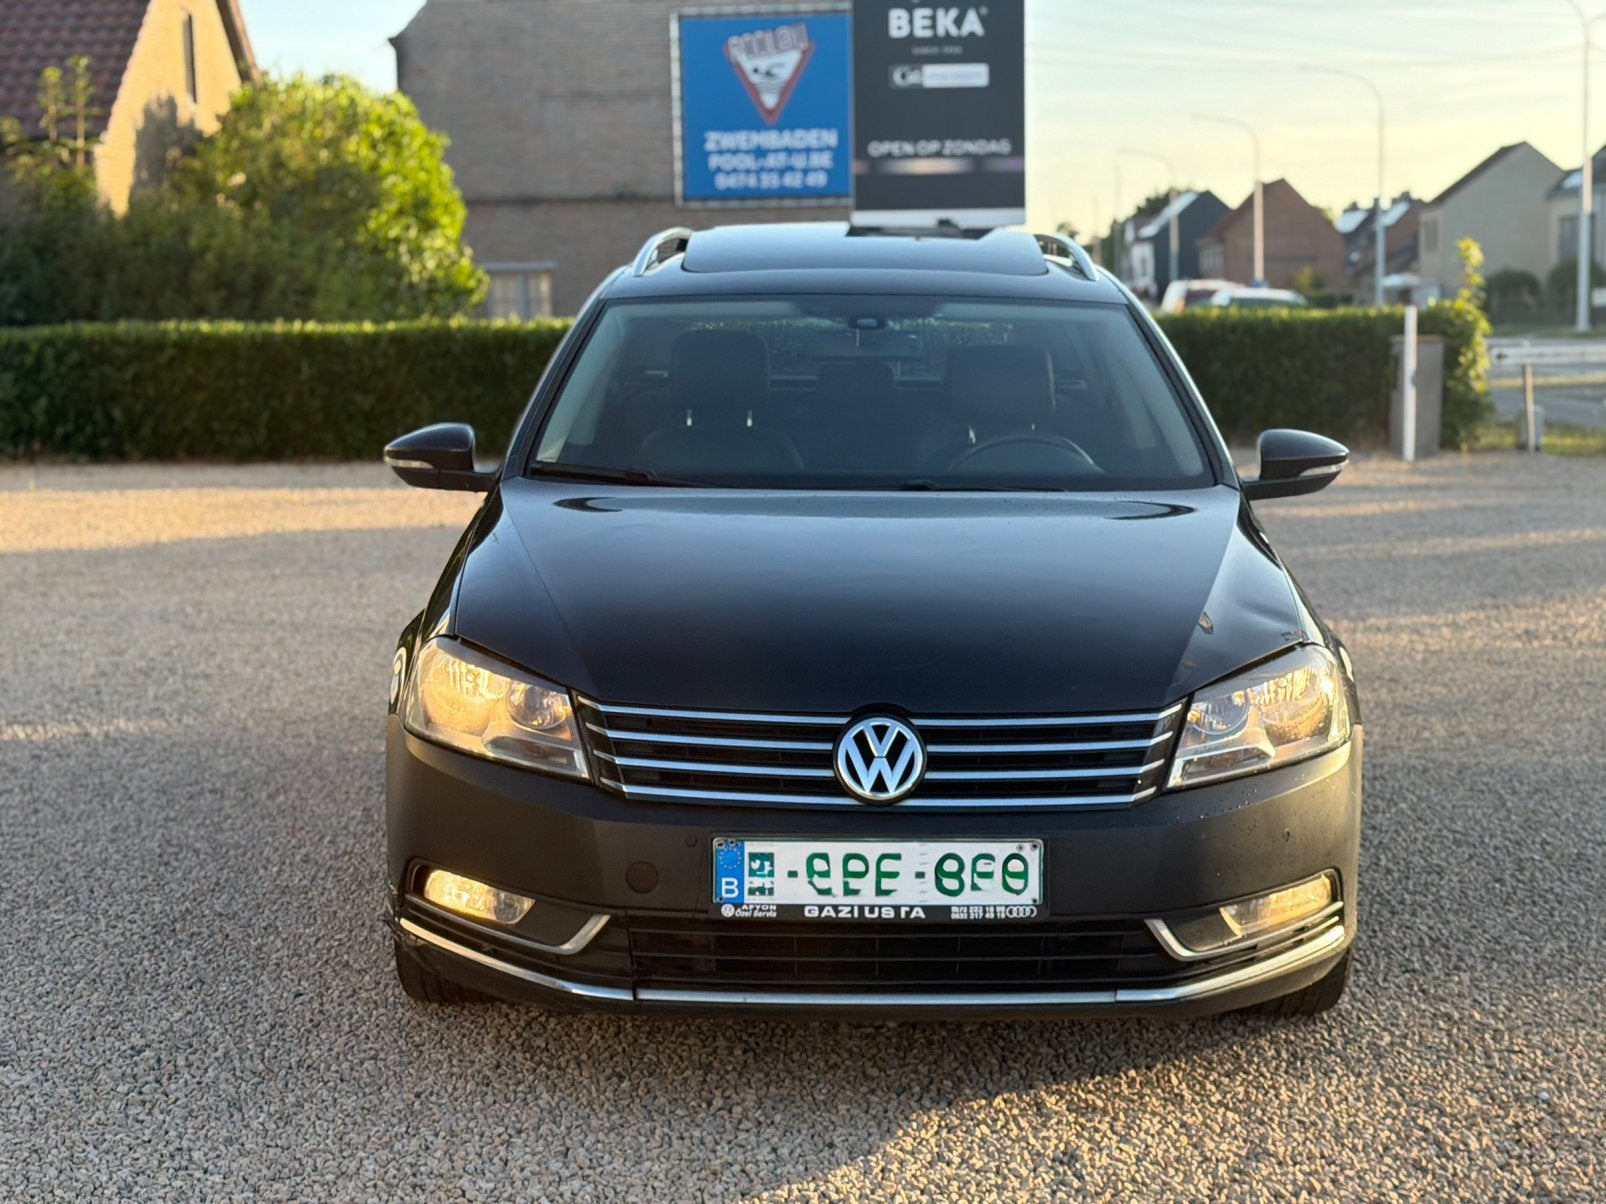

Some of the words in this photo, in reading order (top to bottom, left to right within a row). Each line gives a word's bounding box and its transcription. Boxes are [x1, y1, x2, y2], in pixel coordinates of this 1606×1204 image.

[888, 7, 985, 38] BEKA
[704, 128, 838, 151] ZWEMBADEN
[867, 140, 915, 157] OPEN
[916, 139, 941, 156] OP
[942, 138, 1012, 156] ZONDAG
[839, 719, 921, 798] VW
[721, 877, 739, 898] B
[864, 906, 926, 919] USTA
